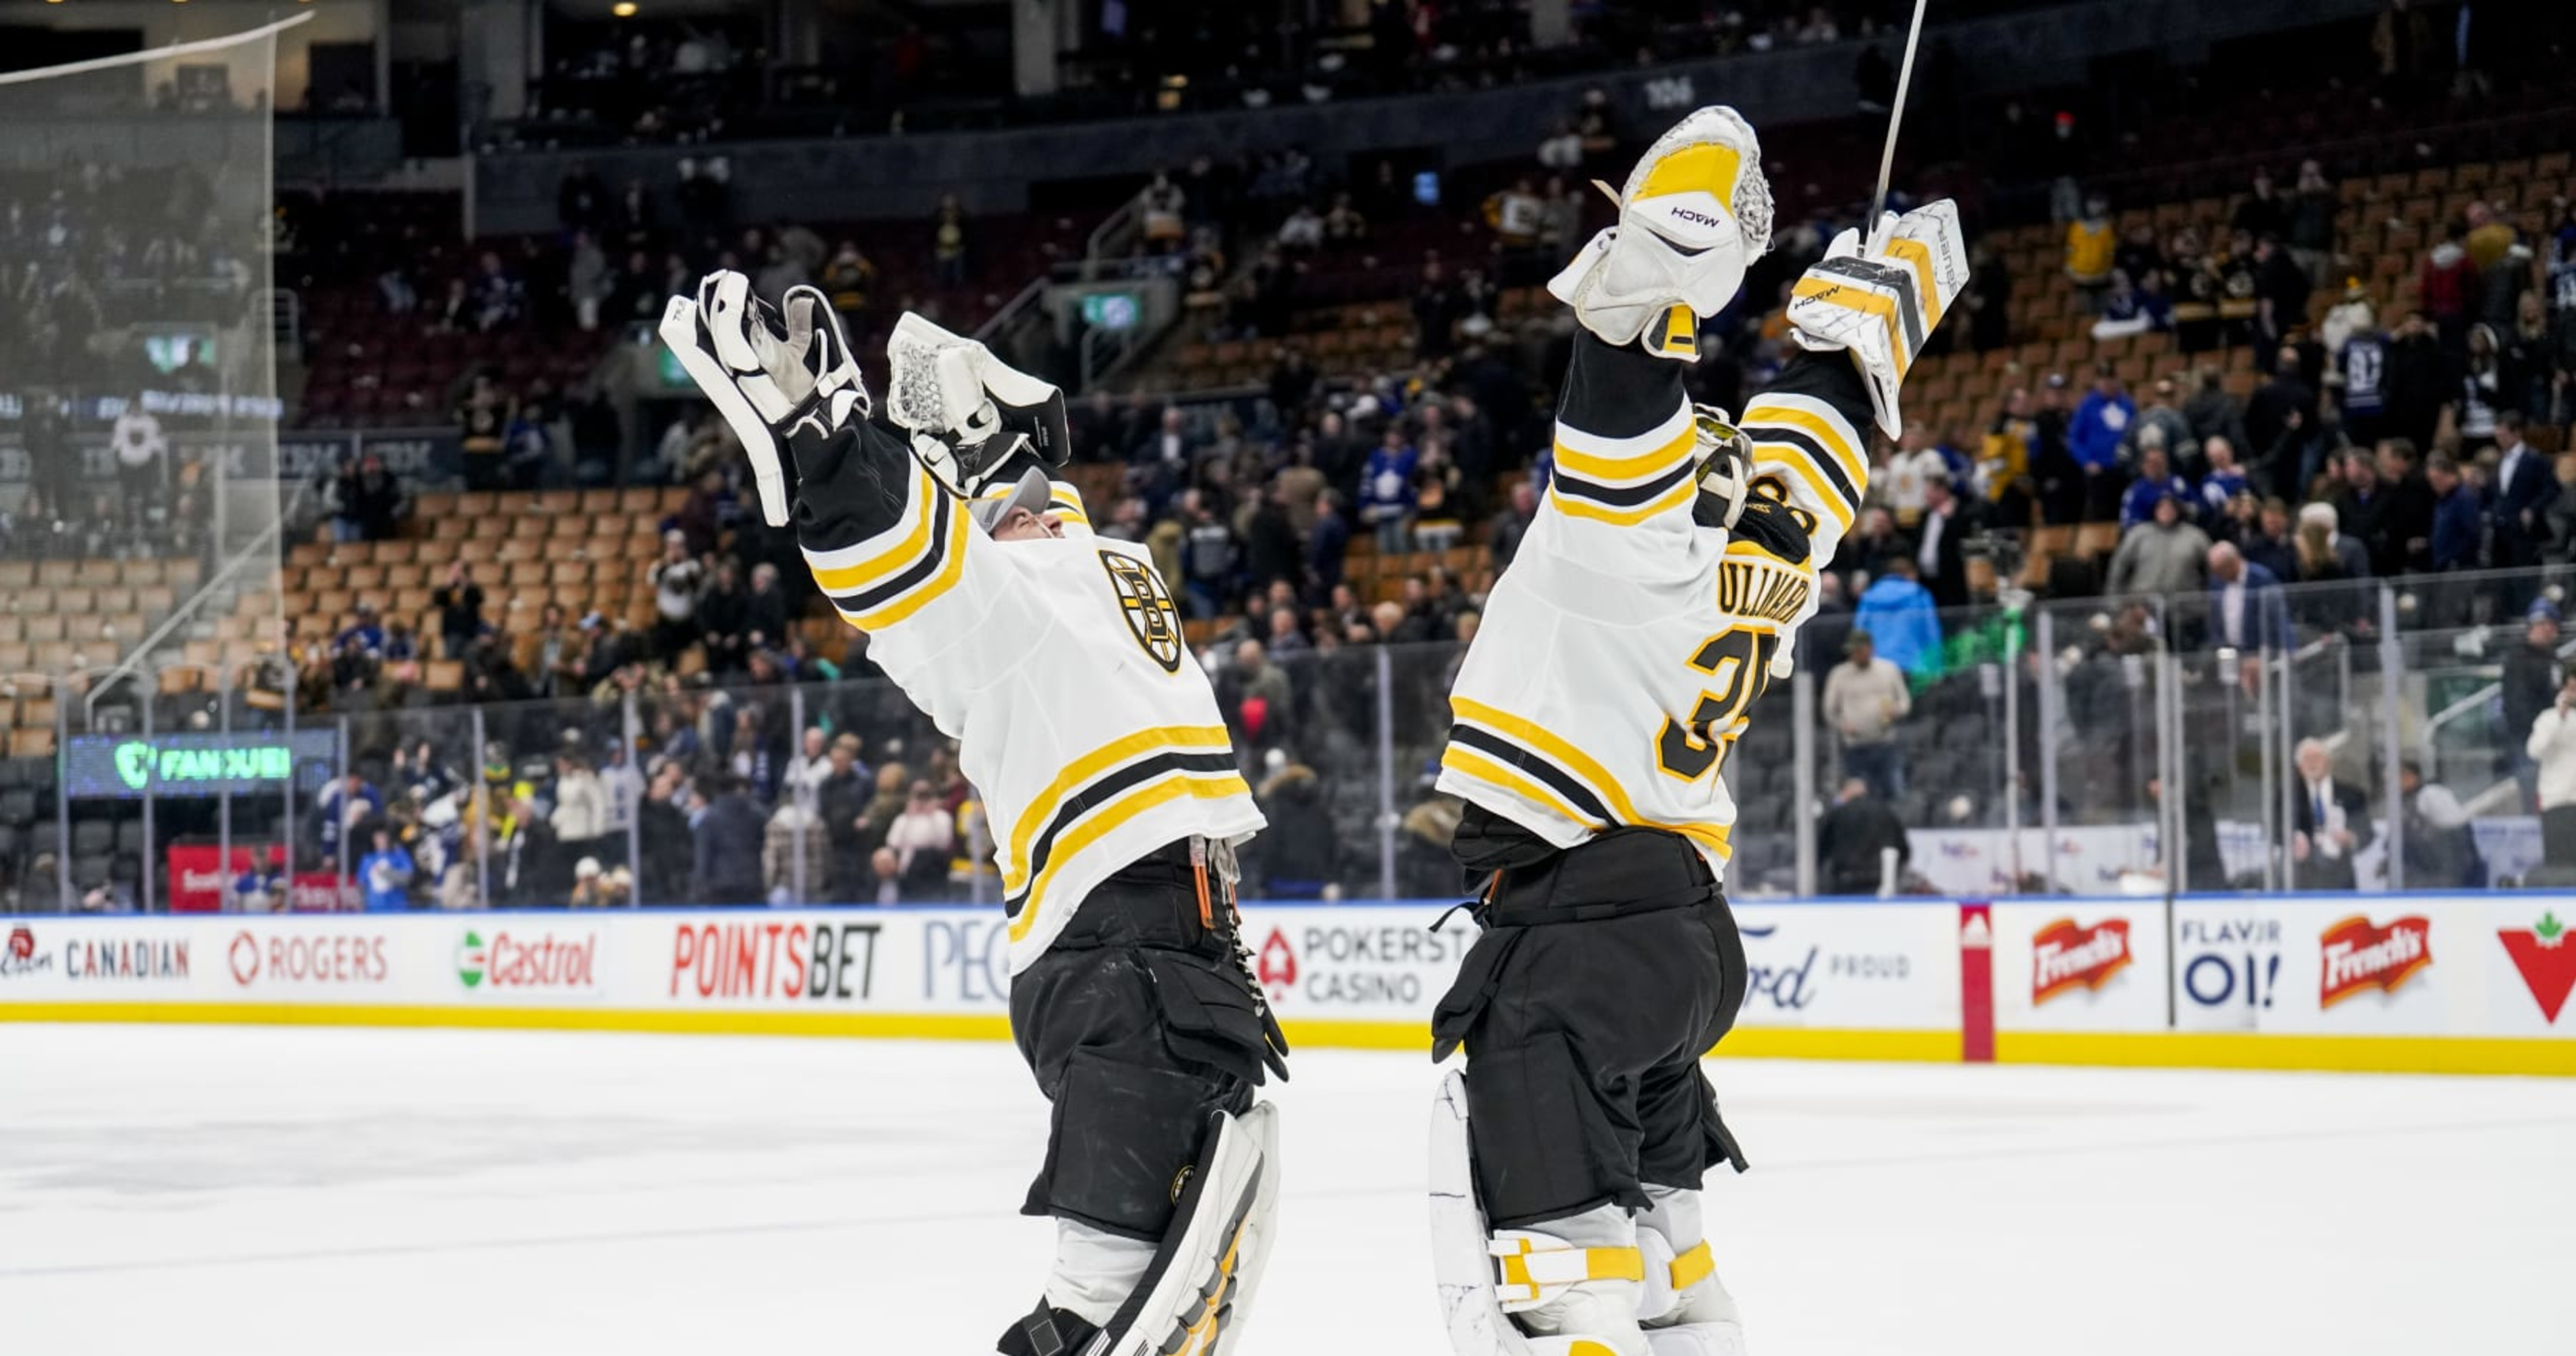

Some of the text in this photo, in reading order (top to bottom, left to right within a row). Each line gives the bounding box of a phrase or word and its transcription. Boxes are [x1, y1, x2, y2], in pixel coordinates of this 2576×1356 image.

[1671, 206, 1720, 228] MACH
[1794, 284, 1840, 310] MACH
[66, 939, 190, 977] CANADIAN
[270, 936, 387, 981] ROGERS
[490, 932, 597, 986] Castrol
[670, 923, 883, 999] POINTSBET
[1830, 955, 1910, 979] PROUD
[1305, 972, 1420, 1003] CASINO
